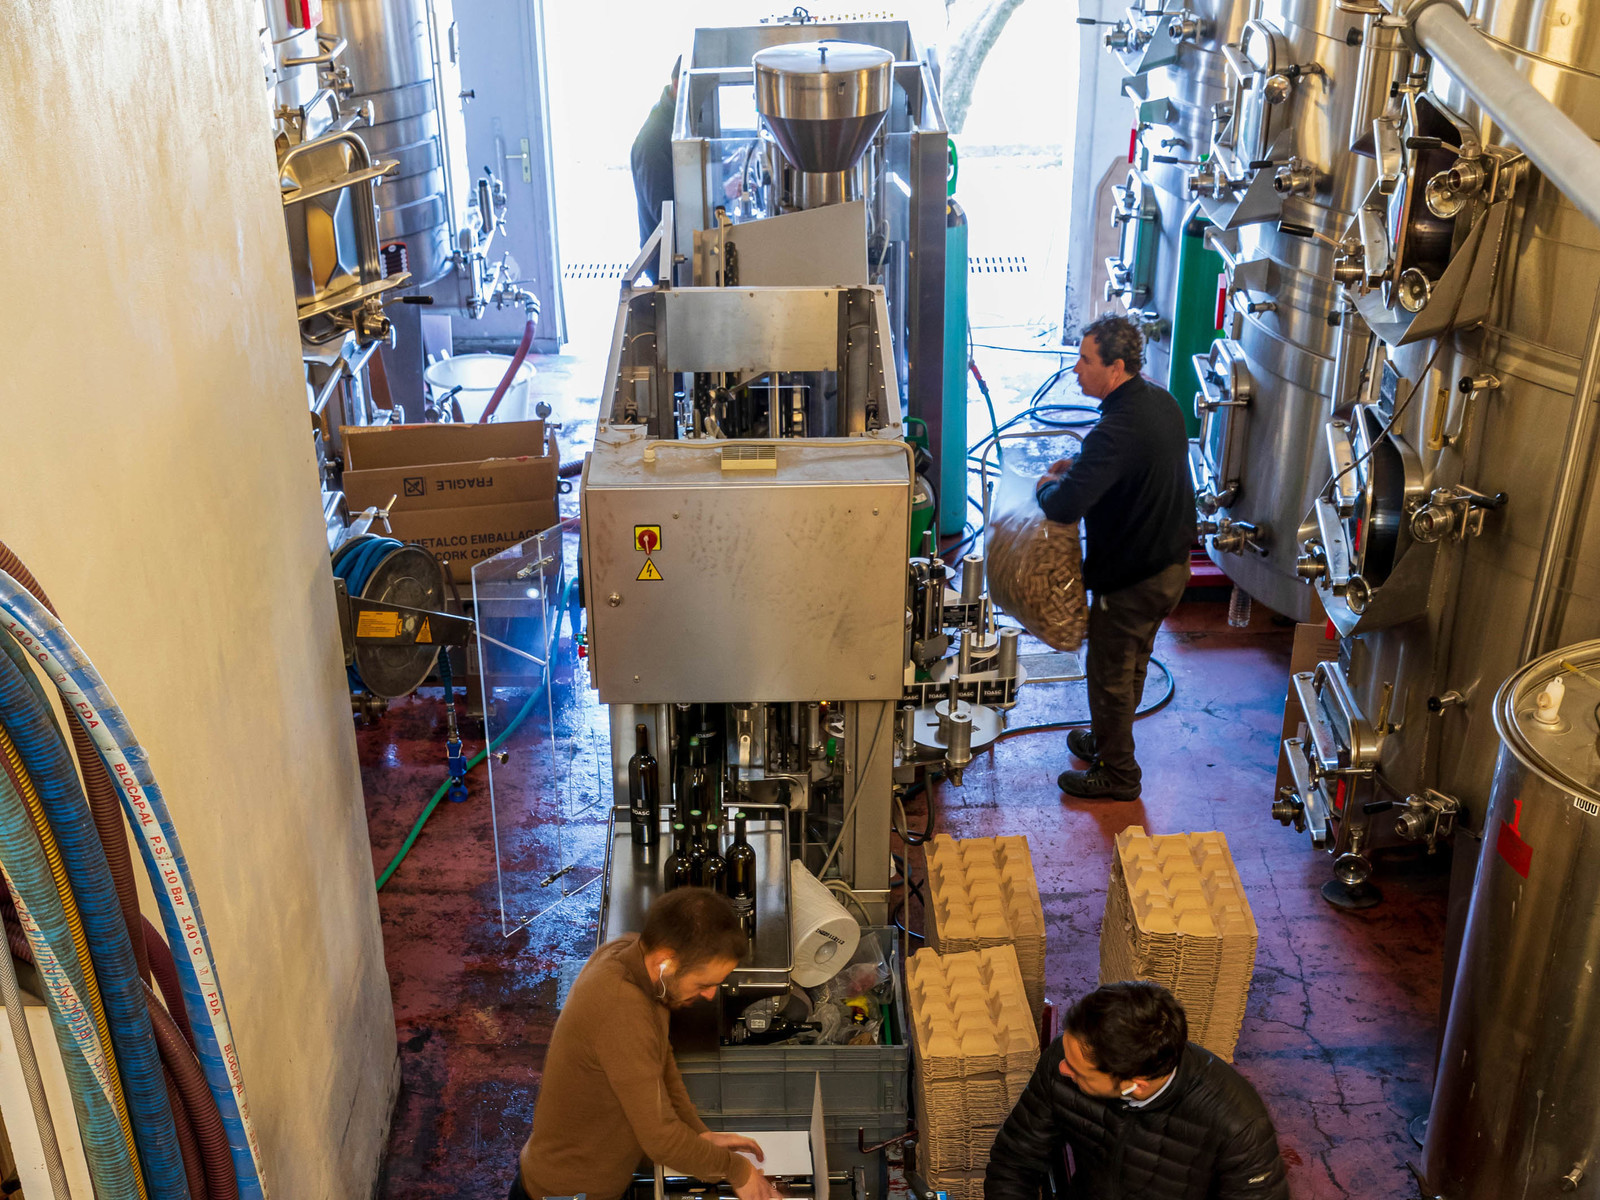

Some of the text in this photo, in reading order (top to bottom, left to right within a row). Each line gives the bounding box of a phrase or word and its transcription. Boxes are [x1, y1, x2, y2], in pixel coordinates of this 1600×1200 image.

[436, 476, 494, 491] FRAGILE
[411, 535, 468, 548] METALCO
[434, 550, 468, 562] CORK
[76, 702, 100, 729] FDA
[114, 762, 154, 828] BLOCAP-AL
[164, 869, 178, 885] 10
[170, 886, 185, 907] Bar
[207, 991, 221, 1016] FDA
[223, 1043, 243, 1098] BLOCAP-AL
